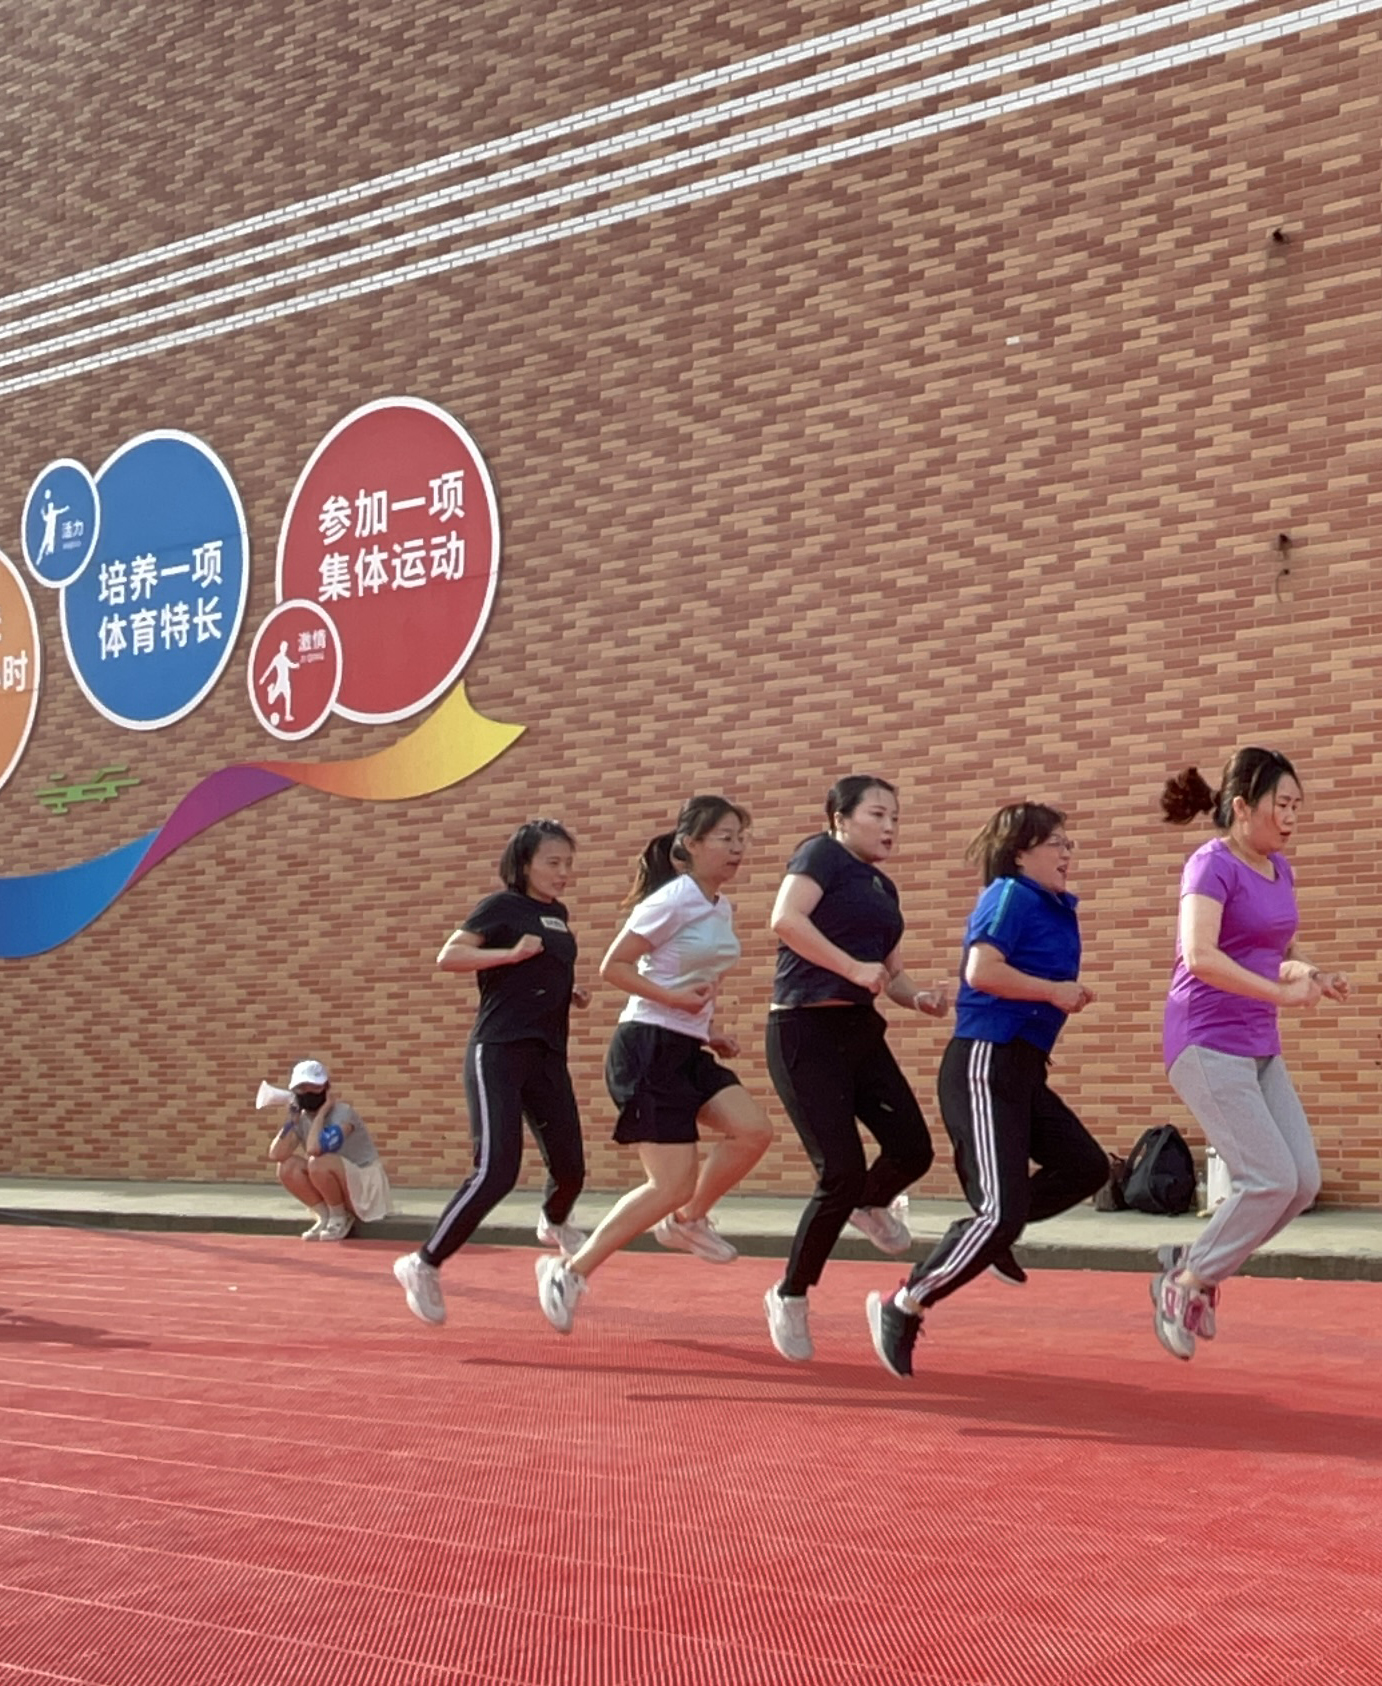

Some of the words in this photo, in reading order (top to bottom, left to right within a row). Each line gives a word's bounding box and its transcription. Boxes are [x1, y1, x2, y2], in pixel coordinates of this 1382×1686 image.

[61, 520, 84, 539] 活力
[318, 469, 465, 546] 参加一项
[98, 540, 223, 606] 培养一项
[318, 530, 465, 602] 集体运动
[98, 596, 222, 660] 体育特长
[298, 629, 326, 652] 激情
